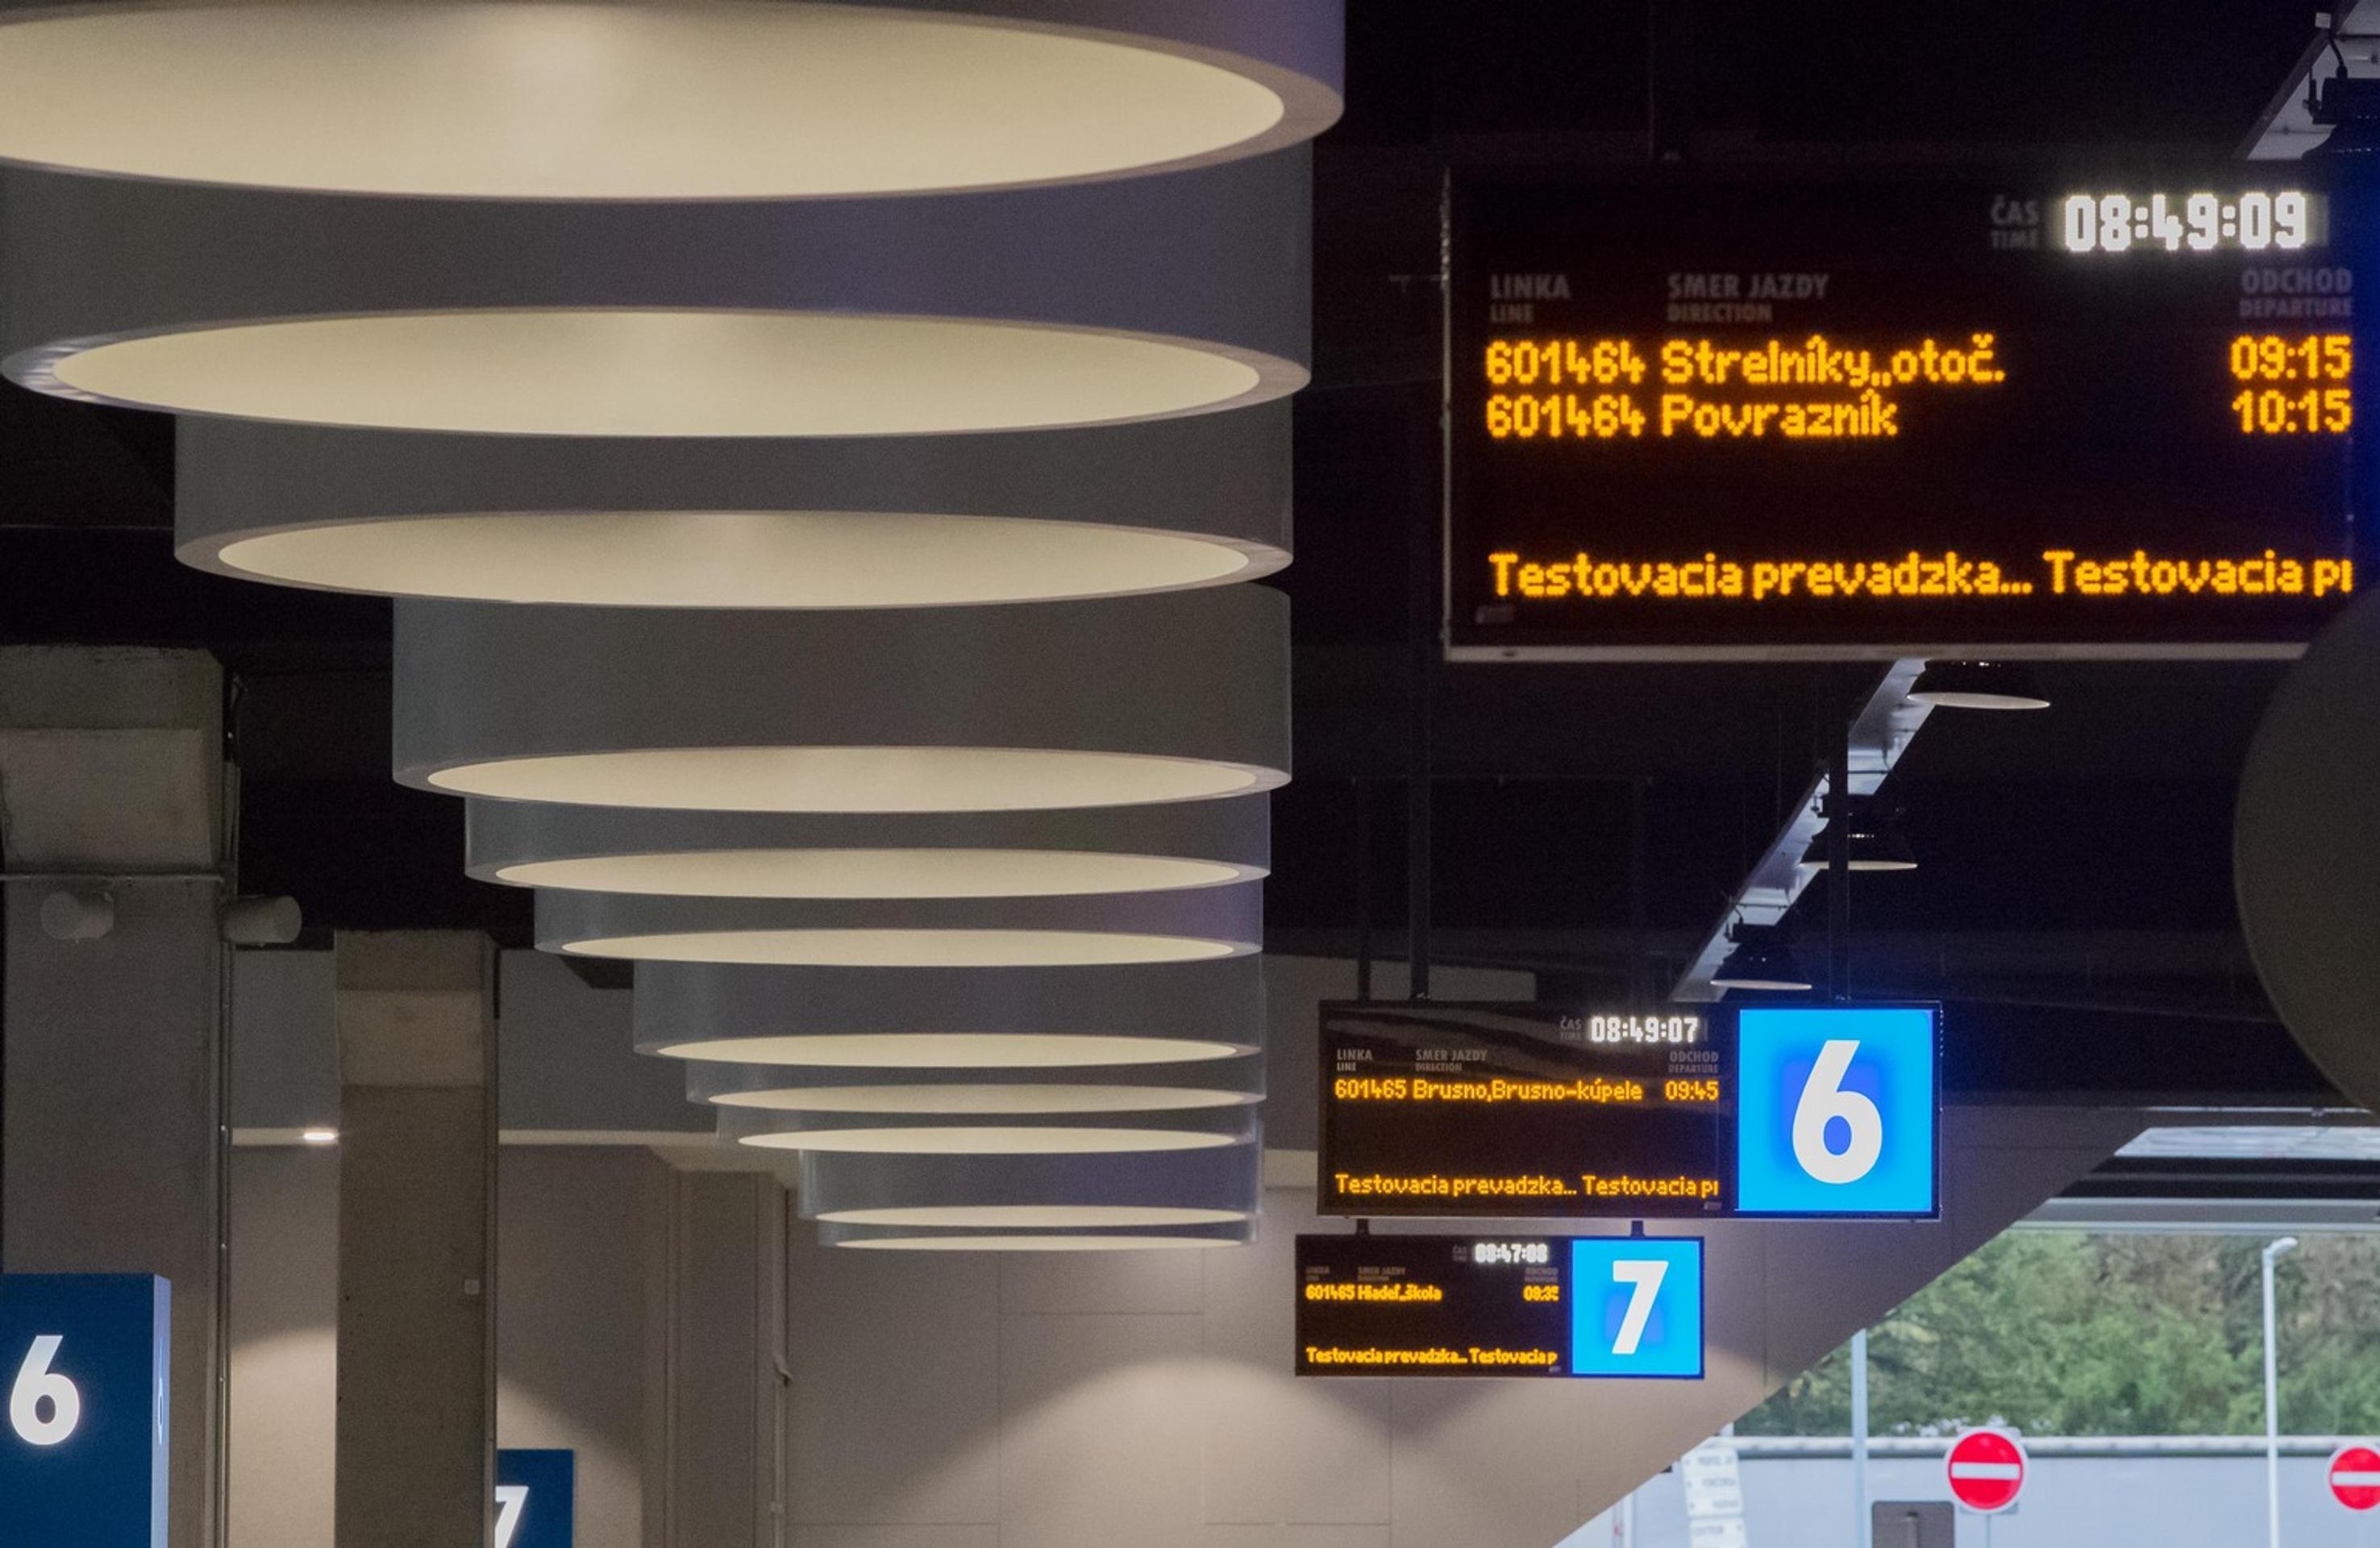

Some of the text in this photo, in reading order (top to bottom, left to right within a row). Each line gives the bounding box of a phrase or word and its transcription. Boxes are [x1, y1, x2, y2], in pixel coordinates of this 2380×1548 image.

[2065, 192, 2307, 251] 08:49:09
[1490, 268, 2353, 300] LINKA SMER JAZDY ODCHOD
[1490, 297, 2354, 323] LINE DIRECTION DEPARTURE
[1486, 339, 1646, 385] 601464
[2230, 335, 2353, 381] 09:15
[1486, 388, 2353, 438] 601464 Povrazník 10:15
[1488, 552, 1744, 597] Testovacia
[1752, 551, 2033, 600] prevadzka...
[2042, 550, 2304, 595] Testovacia
[1590, 1016, 1699, 1043] 08:49:07
[1337, 1049, 1719, 1063] LINKA SMER JAZDY ODCHOD
[1334, 1079, 1408, 1100] 601465
[1665, 1080, 1719, 1101] 09:45
[1792, 1039, 1883, 1184] 6
[1335, 1174, 1450, 1195] Testovacia
[1452, 1175, 1577, 1197] prevadzka...
[1582, 1175, 1697, 1196] Testovacia
[1612, 1260, 1669, 1354] 7
[1306, 1347, 1383, 1363] Testovacia
[1469, 1348, 1547, 1364] Testovacia
[10, 1335, 80, 1445] 6
[494, 1486, 529, 1548] 7
